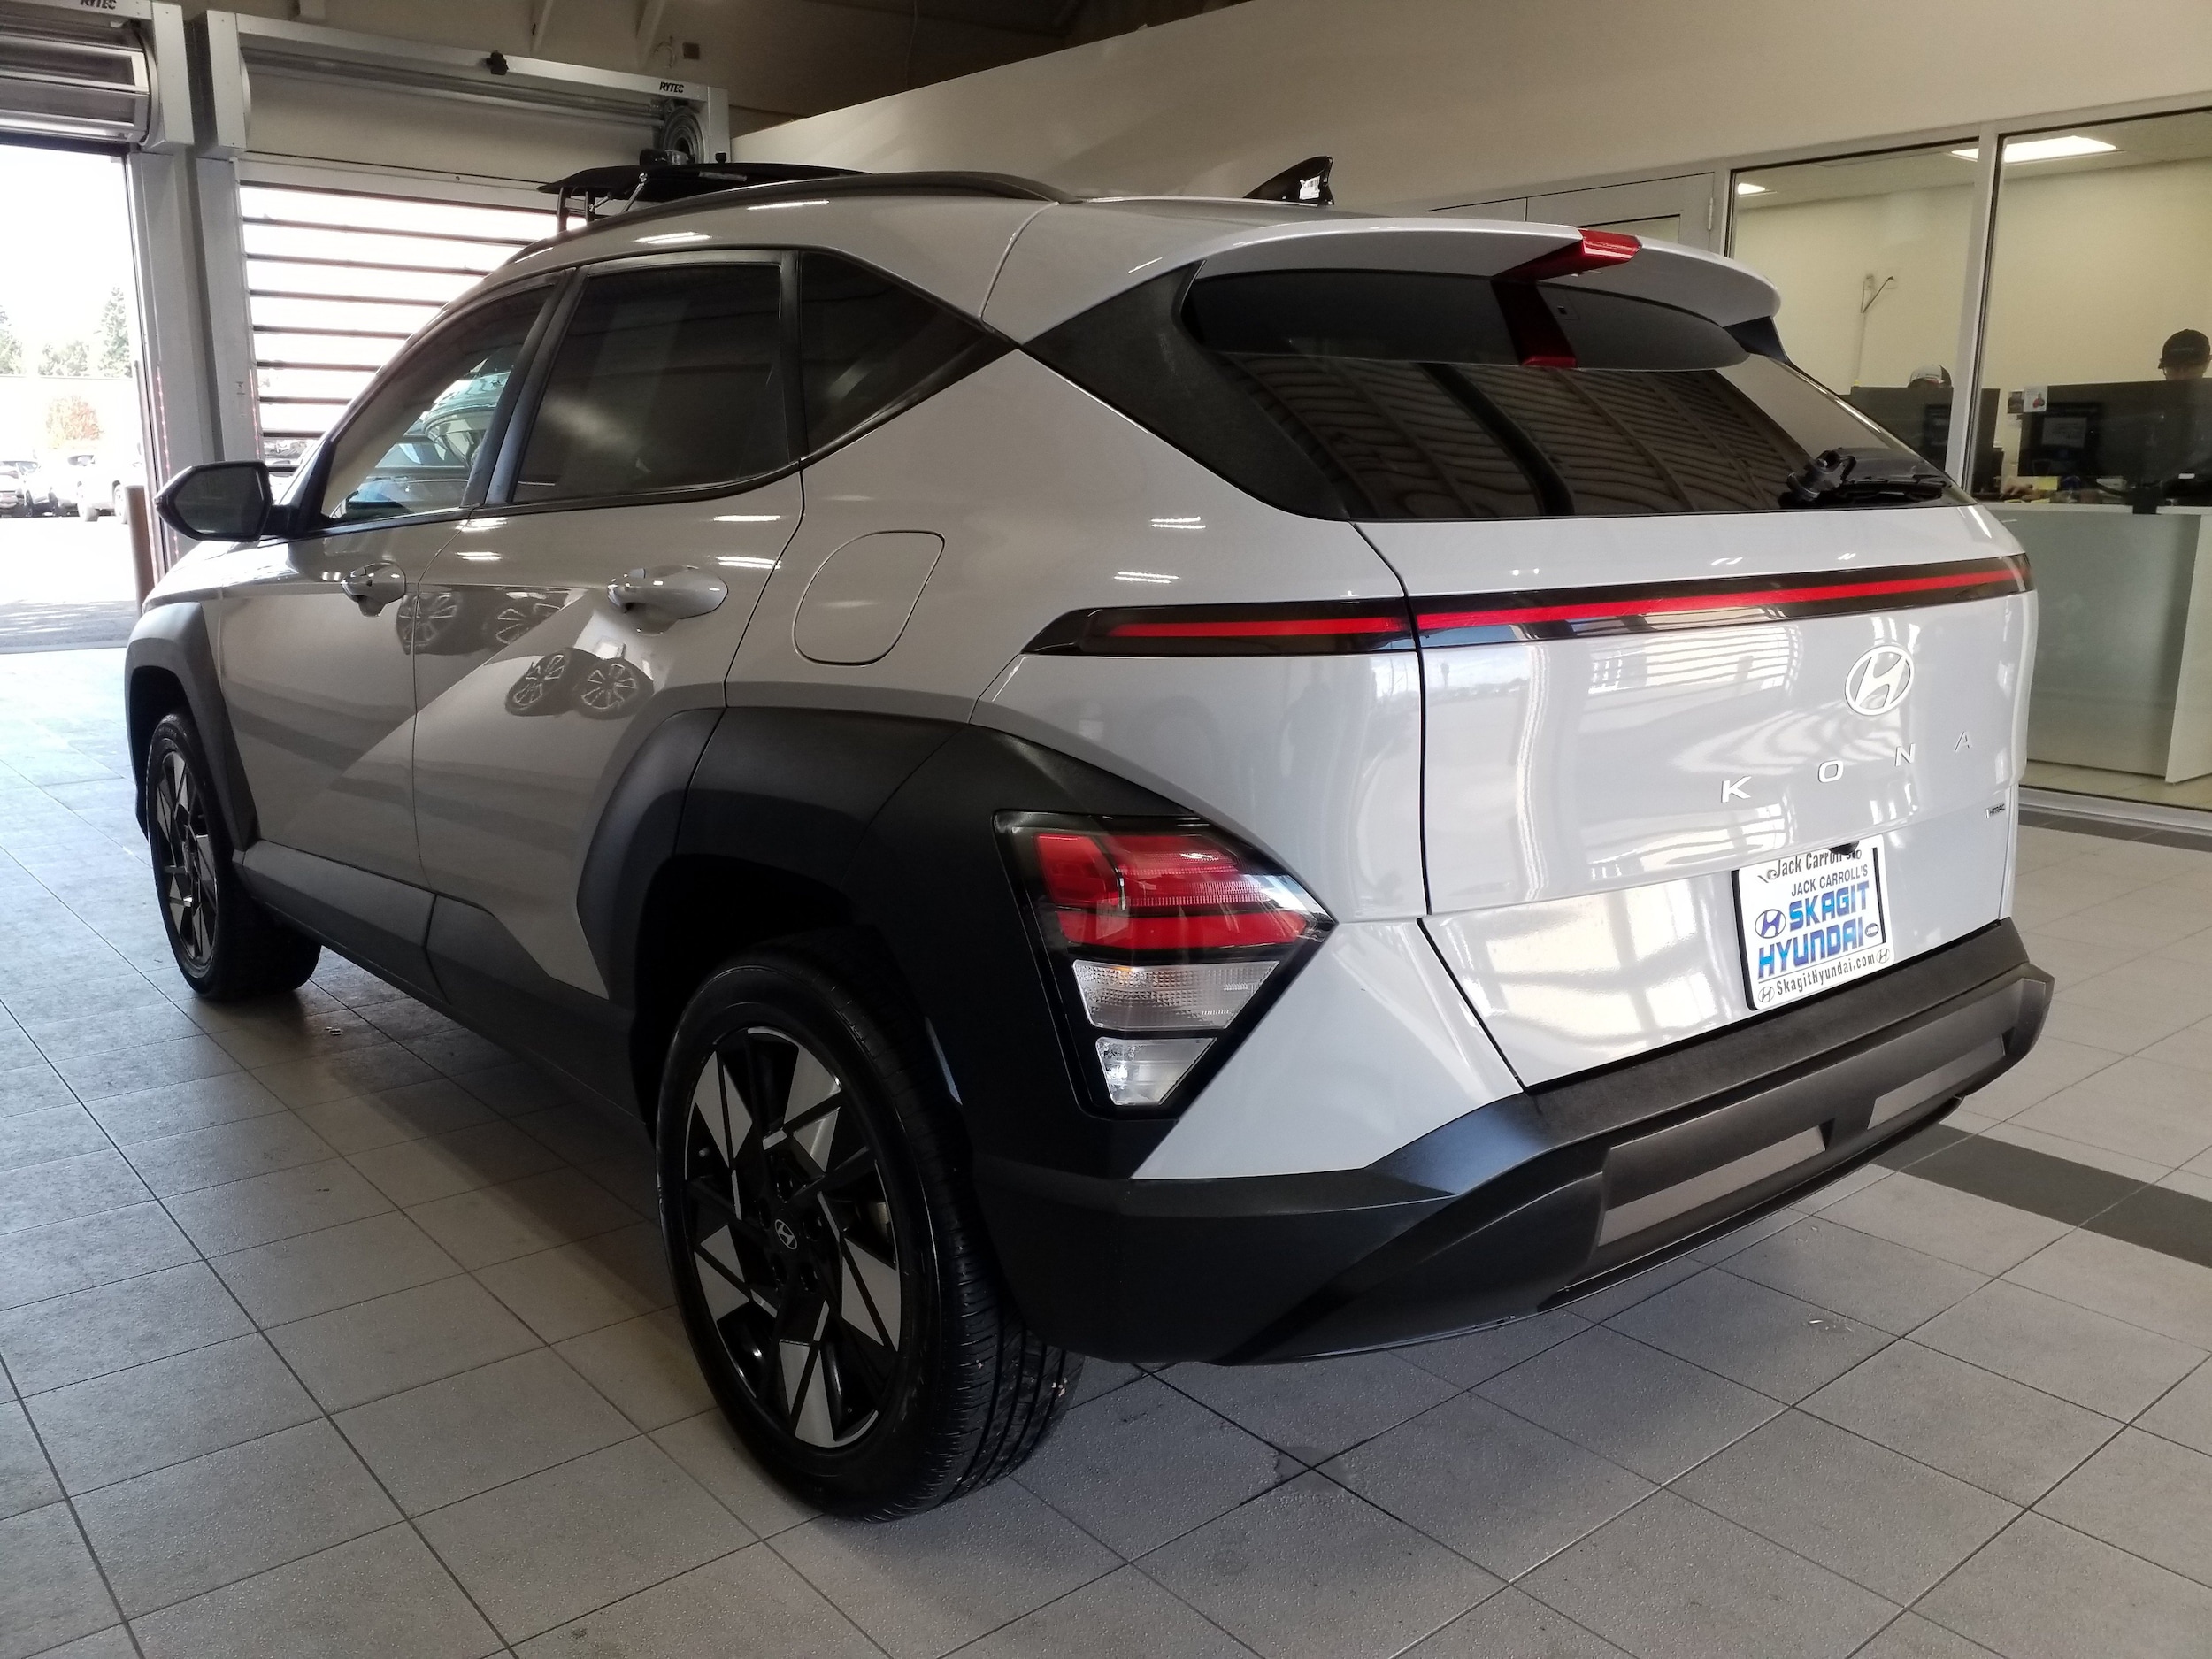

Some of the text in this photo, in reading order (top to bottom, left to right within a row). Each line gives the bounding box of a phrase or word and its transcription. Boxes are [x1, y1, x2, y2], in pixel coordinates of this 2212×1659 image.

[659, 81, 684, 93] RYTEC
[1720, 731, 1972, 803] KONA
[1777, 851, 1851, 878] Jack Carro
[1791, 864, 1869, 896] JACK CARROLL'S
[1788, 880, 1870, 932] SKAGIT
[1757, 917, 1864, 979] HYUNDAI
[1777, 953, 1875, 995] SkagitHyundai.com
